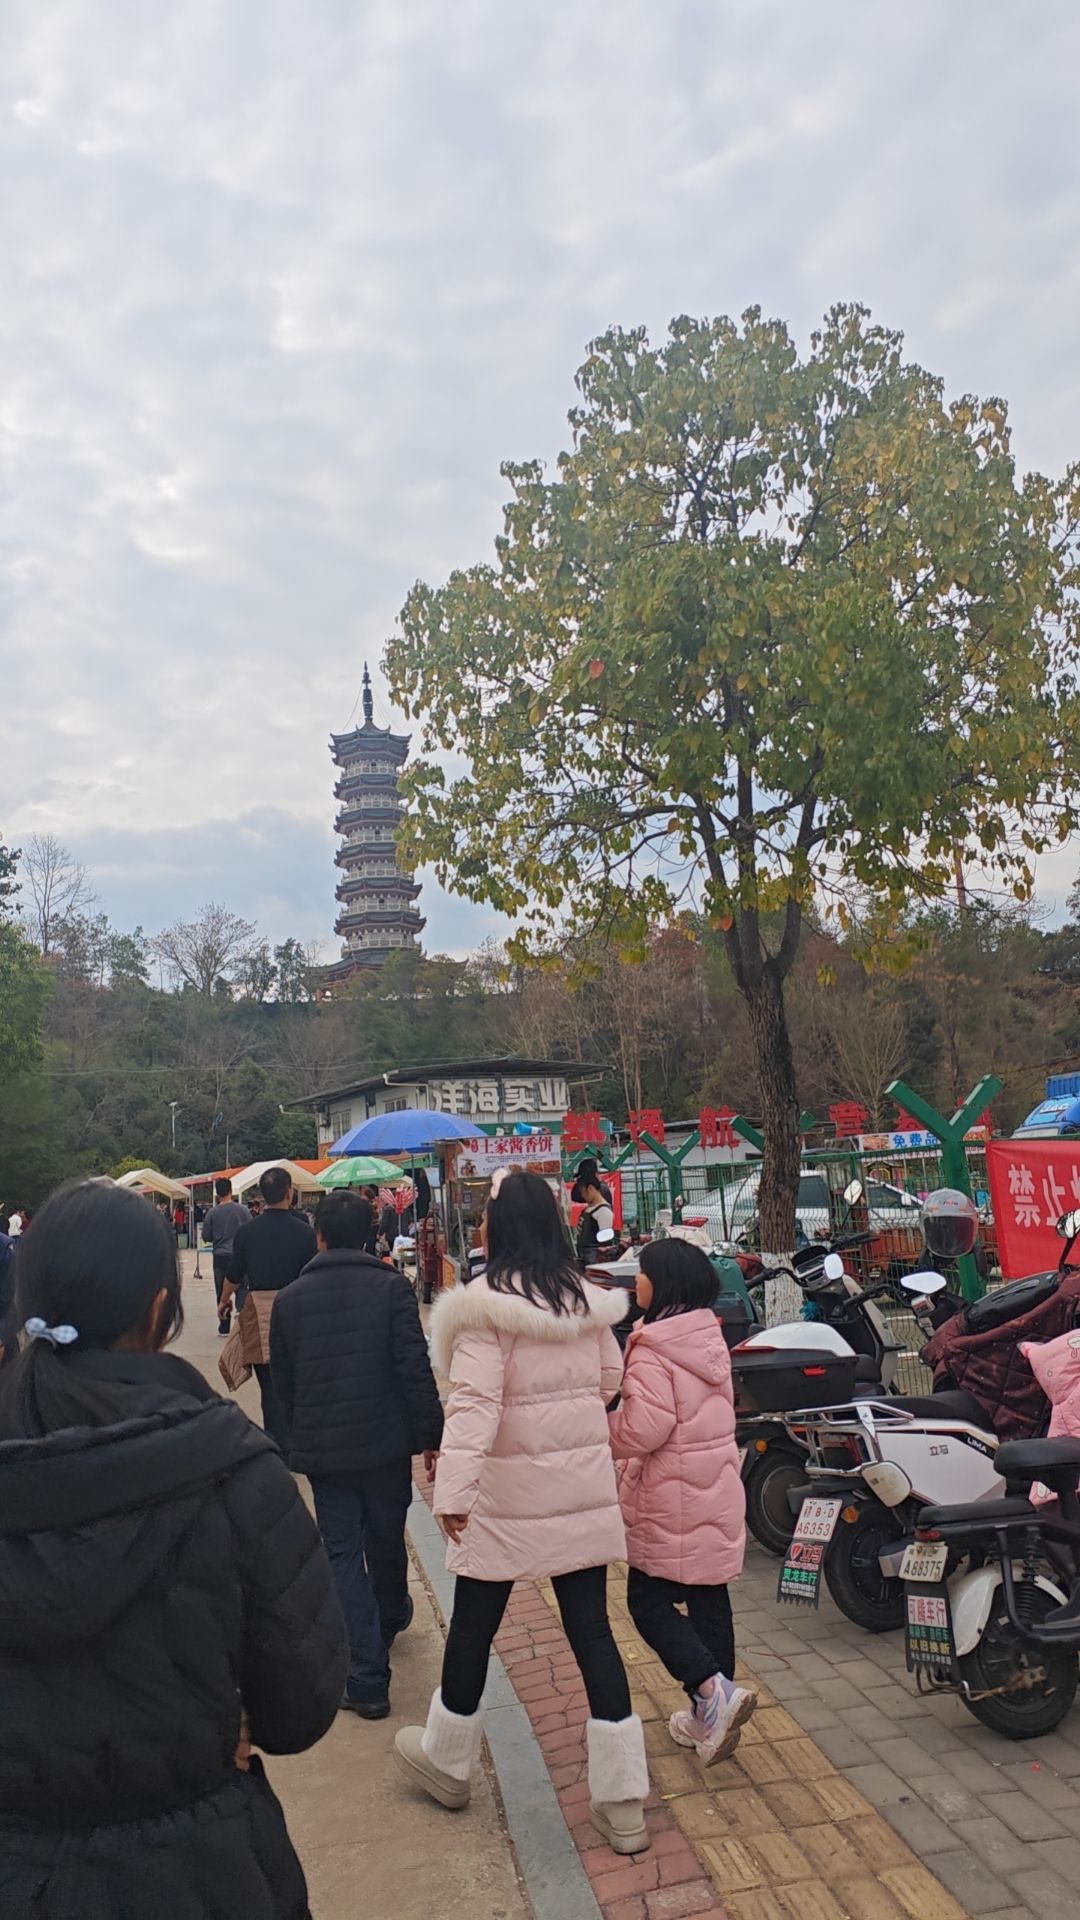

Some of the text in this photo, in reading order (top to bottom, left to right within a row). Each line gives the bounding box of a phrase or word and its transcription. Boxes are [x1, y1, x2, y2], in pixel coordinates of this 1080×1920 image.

[433, 1080, 569, 1114] 洋海实业
[480, 1135, 554, 1154] 土家酱香饼
[1008, 1163, 1080, 1228] 禁止
[929, 1444, 949, 1457] 立马
[967, 1437, 988, 1453] LIMA
